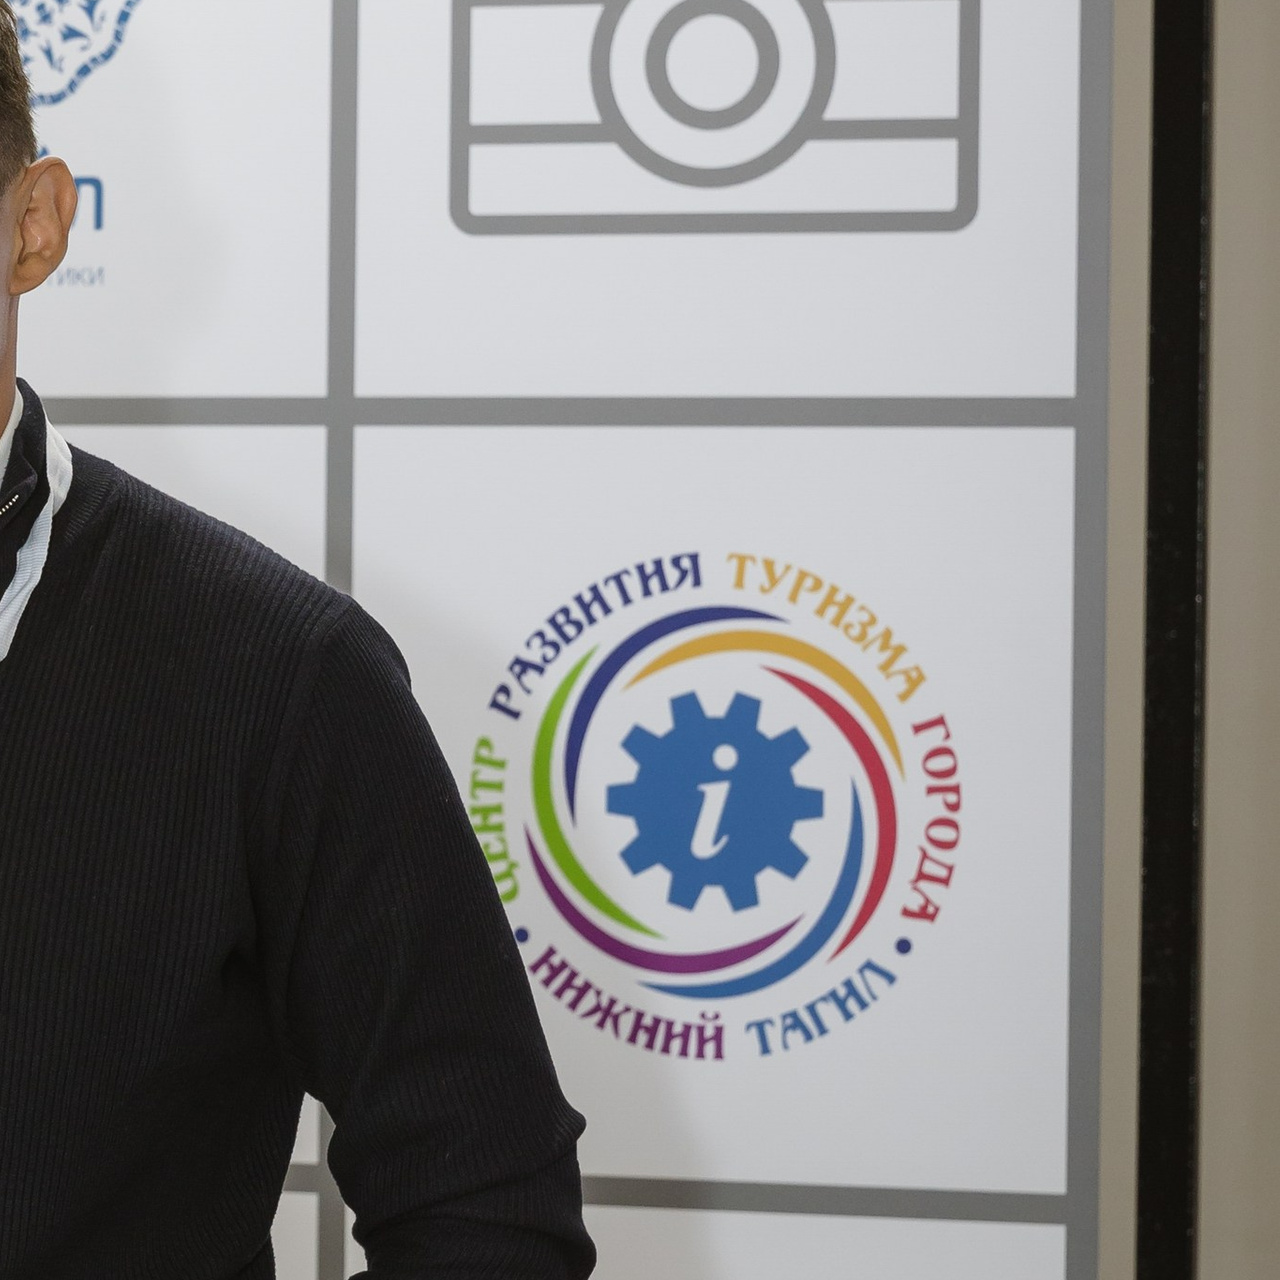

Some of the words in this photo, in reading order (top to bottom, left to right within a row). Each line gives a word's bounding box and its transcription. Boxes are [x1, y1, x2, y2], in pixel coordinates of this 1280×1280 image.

[489, 552, 703, 720] РАЗВИТИЯ
[726, 553, 928, 704] ТУРИЗМА
[902, 714, 962, 925] ГОРОДА
[529, 943, 725, 1061] НИЖНИЙ
[746, 958, 898, 1057] ТАГИЛ
